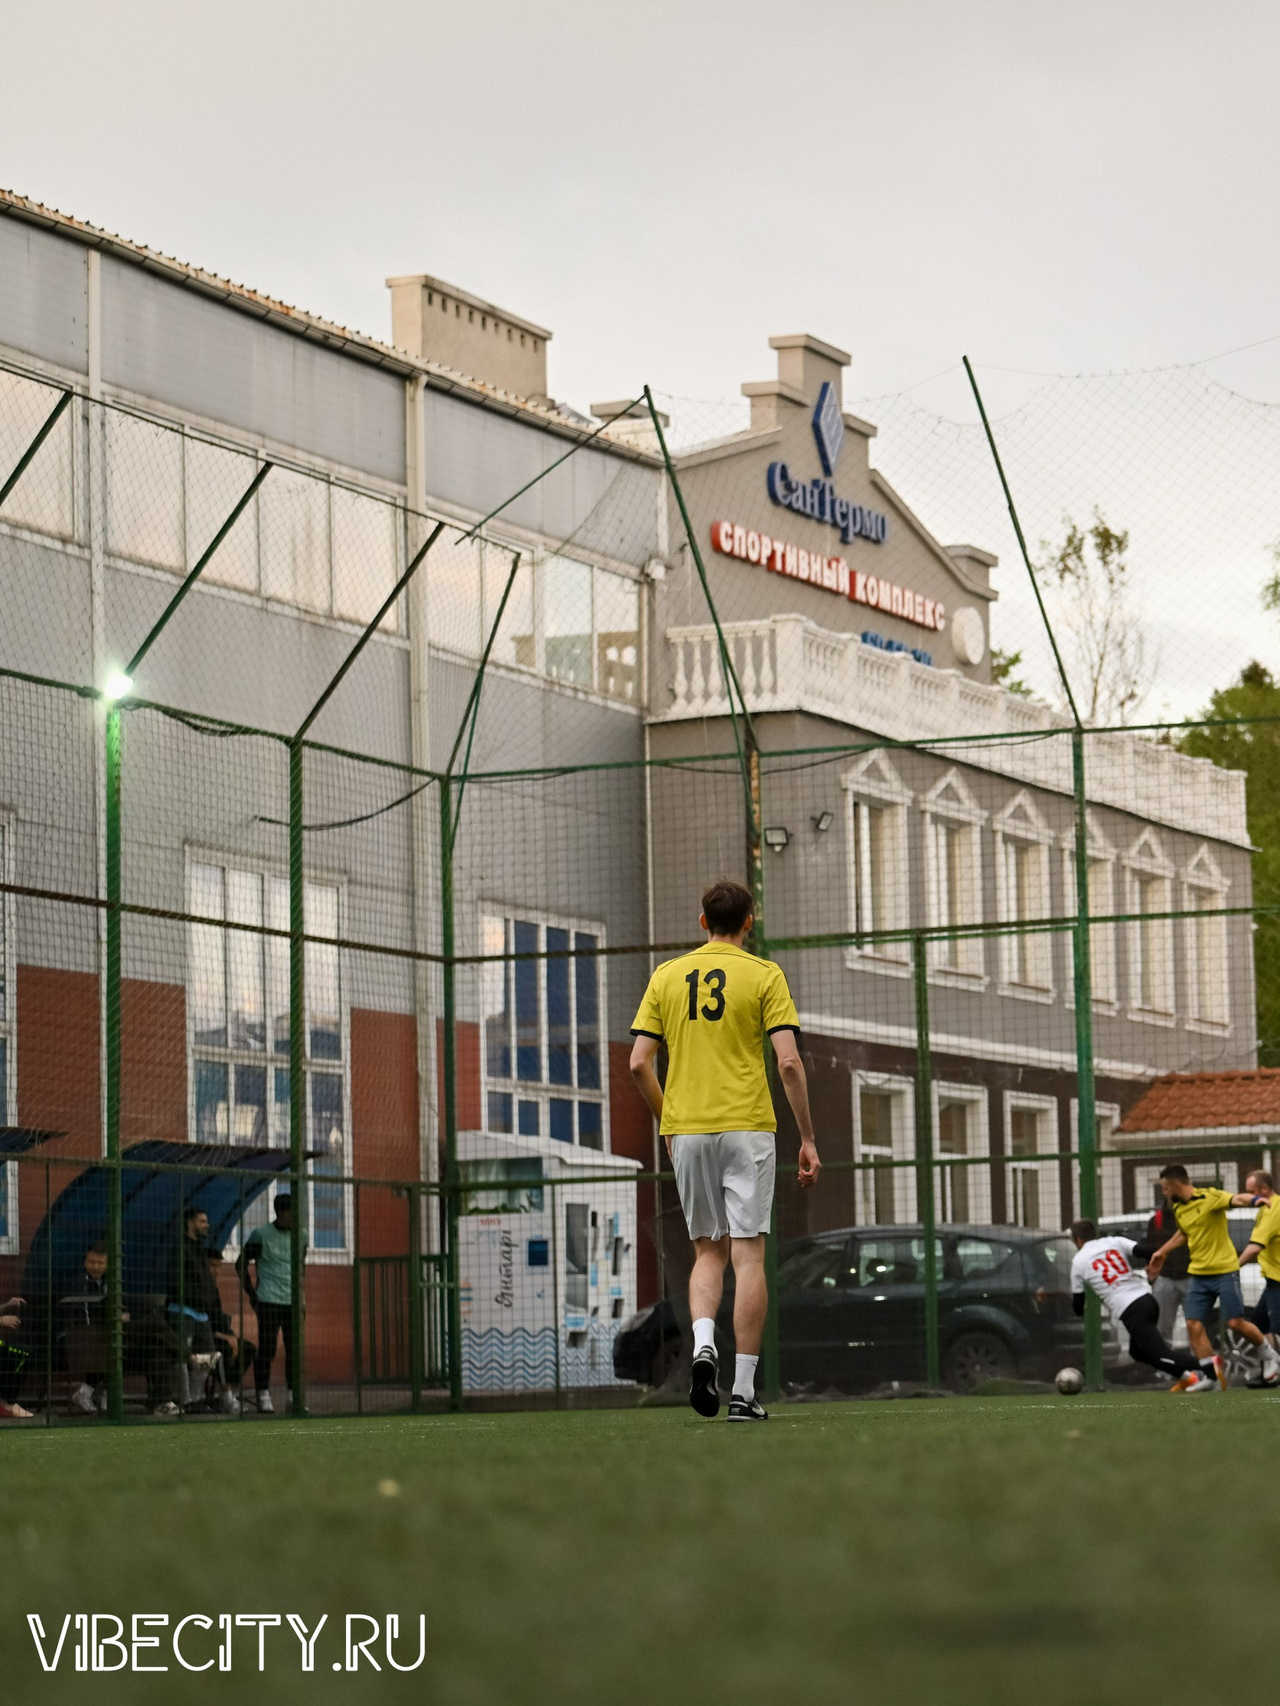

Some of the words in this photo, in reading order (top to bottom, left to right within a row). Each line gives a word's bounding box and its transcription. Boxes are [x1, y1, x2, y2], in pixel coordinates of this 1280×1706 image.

[711, 521, 850, 596] СПОРТИВНЫЙ
[849, 570, 946, 632] КОМПЛЕКС
[685, 968, 727, 1022] 13
[1092, 1249, 1129, 1286] 20
